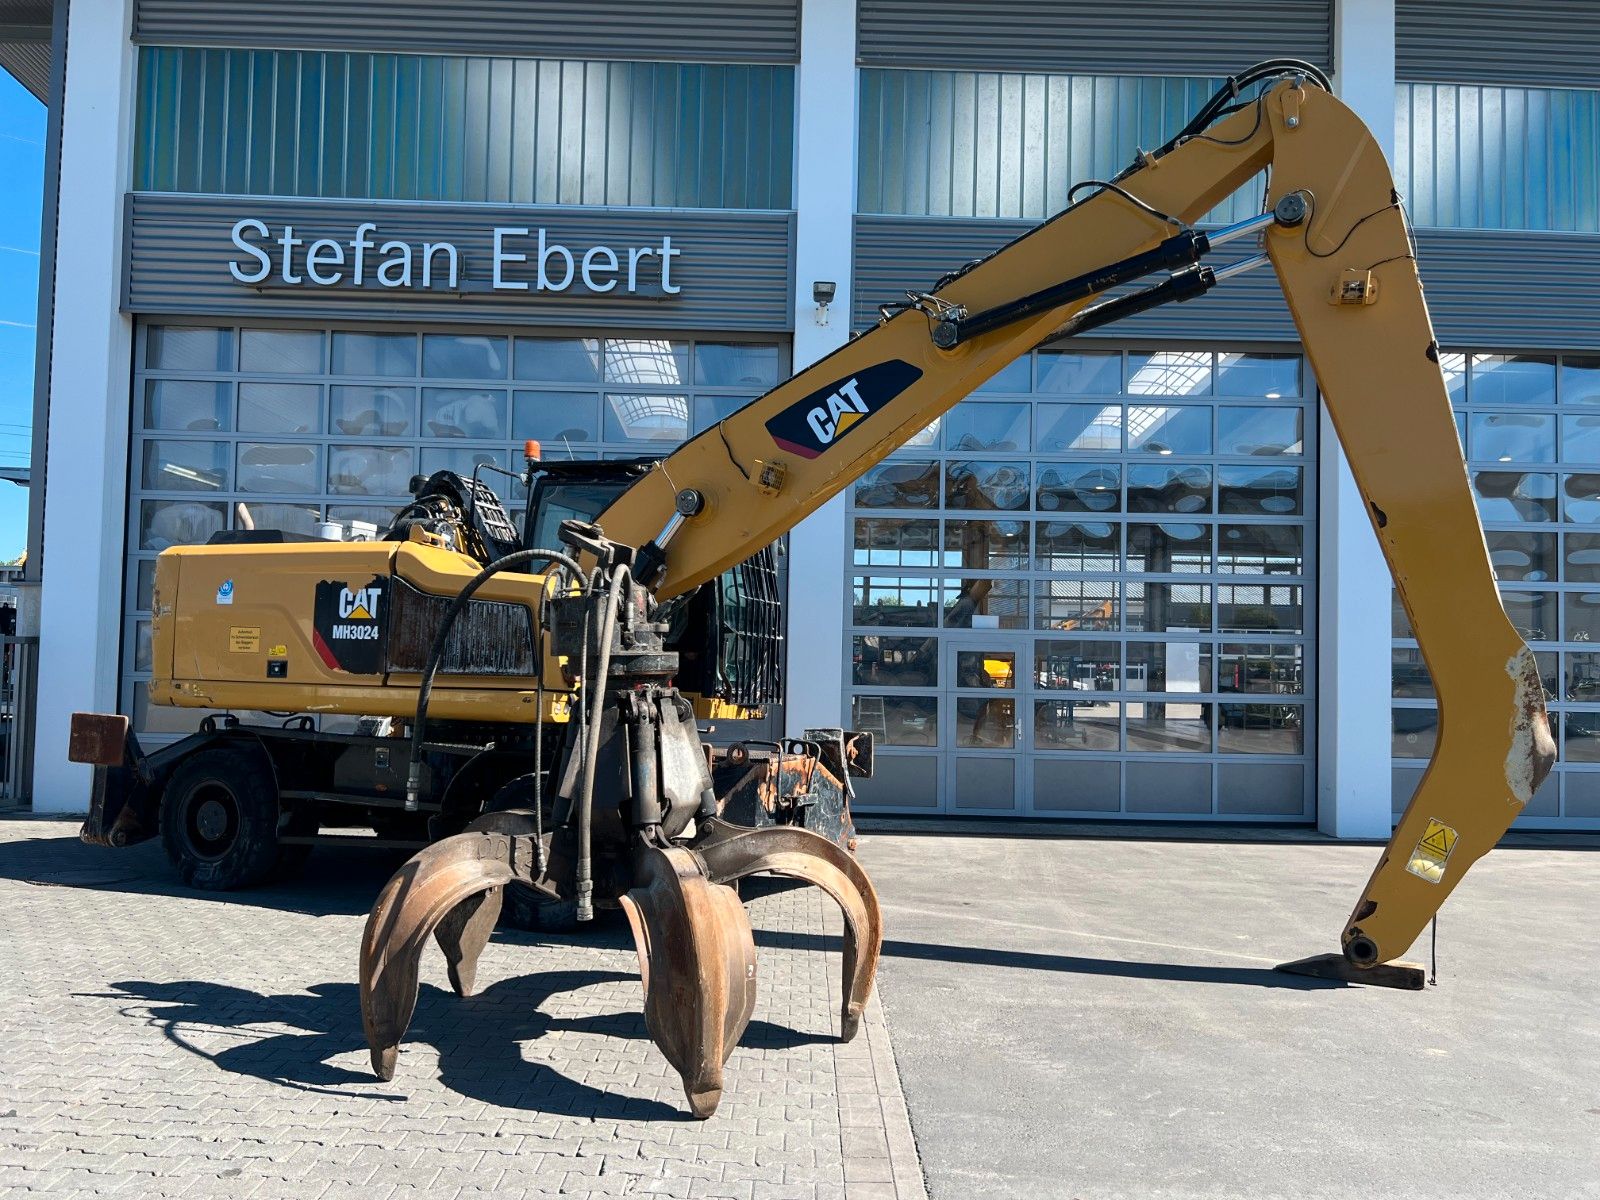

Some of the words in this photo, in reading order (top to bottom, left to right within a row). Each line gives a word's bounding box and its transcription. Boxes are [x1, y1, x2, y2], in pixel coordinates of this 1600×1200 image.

[229, 219, 457, 287] Stefan
[493, 227, 680, 293] Ebert
[806, 378, 869, 443] CAT
[339, 588, 381, 618] CAT
[332, 625, 379, 639] MH3024
